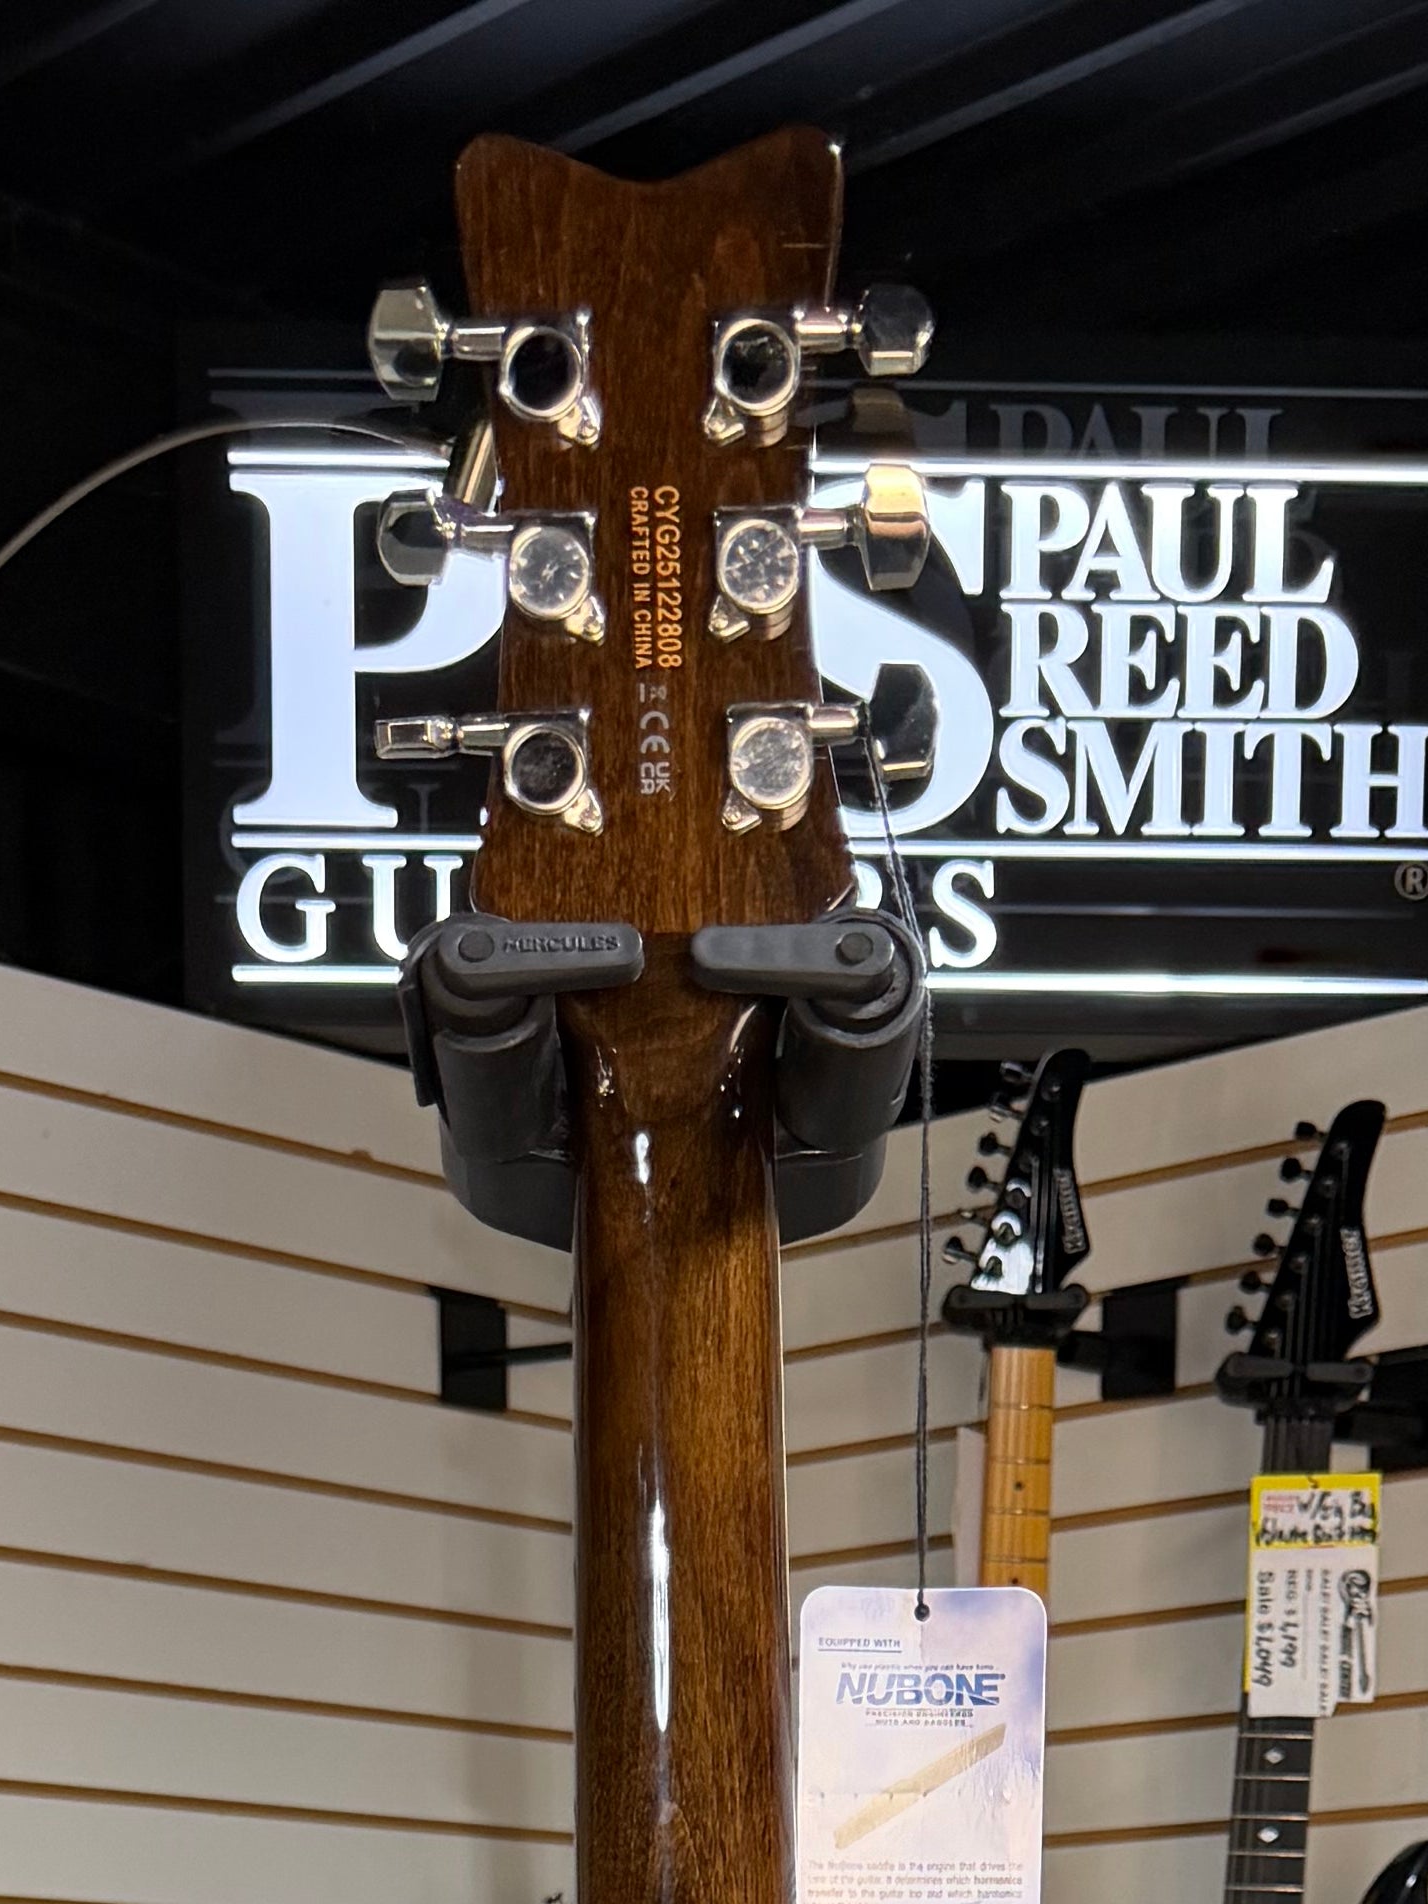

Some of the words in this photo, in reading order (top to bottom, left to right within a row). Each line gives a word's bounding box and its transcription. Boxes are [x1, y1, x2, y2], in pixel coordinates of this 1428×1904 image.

[630, 486, 650, 576] CRAFTED
[1000, 483, 1336, 604] PAUL
[632, 582, 651, 602] IN
[654, 485, 683, 669] CYG25122808
[633, 611, 653, 670] CHINA
[1002, 602, 1362, 720] REED
[502, 935, 620, 955] HERCULES
[1256, 1570, 1275, 1615] Sale
[874, 1639, 901, 1648] WITH
[836, 1673, 1000, 1706] NUBONE
